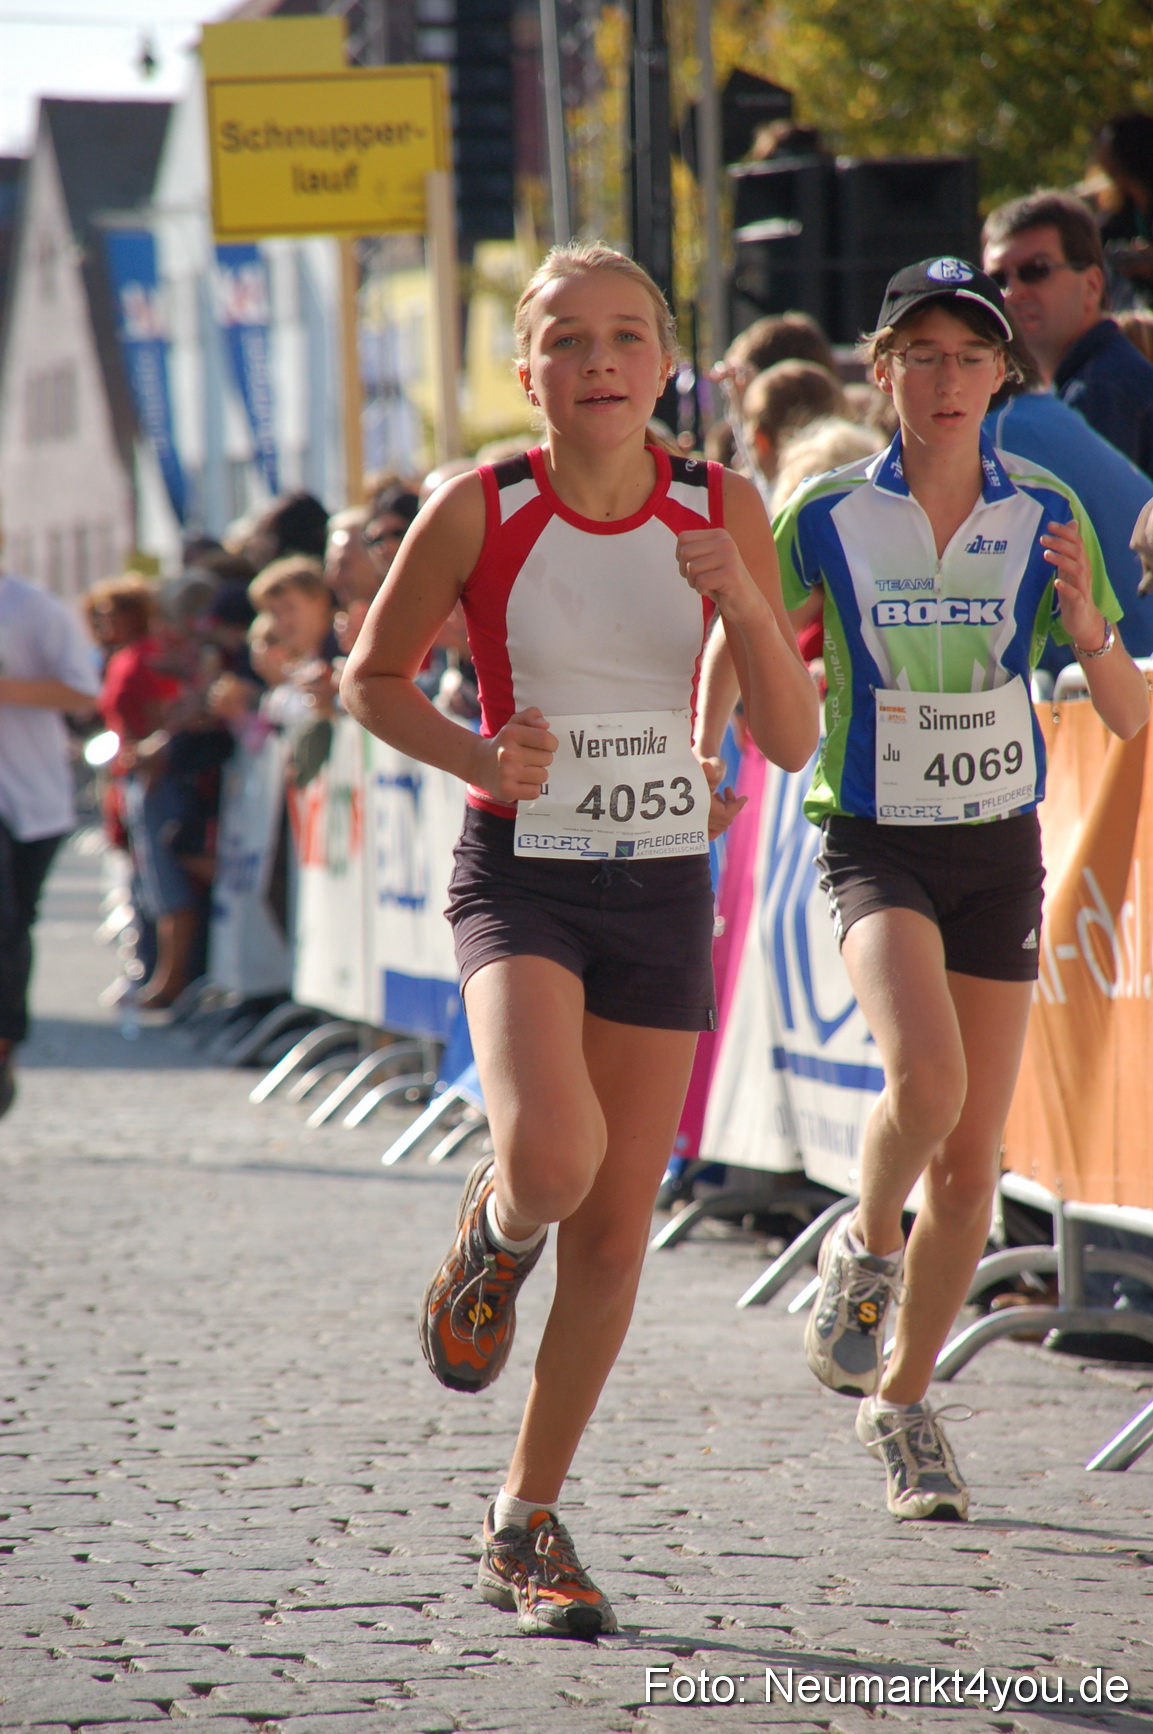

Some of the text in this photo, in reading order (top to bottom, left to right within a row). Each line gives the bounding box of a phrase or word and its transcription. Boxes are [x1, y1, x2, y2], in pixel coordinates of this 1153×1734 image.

[220, 120, 427, 155] Schnupper-
[292, 163, 358, 193] lauf
[875, 578, 934, 591] TEAM
[871, 597, 1006, 627] BOCK
[919, 705, 996, 730] Simone
[569, 727, 667, 758] Veronika
[882, 743, 900, 762] Ju
[924, 740, 1023, 787] 4069
[576, 776, 695, 822] 4053
[981, 784, 1033, 809] PFLEIDERER
[879, 805, 941, 818] BOCK
[518, 834, 591, 850] BOCK
[637, 831, 705, 850] PFLEIDERER
